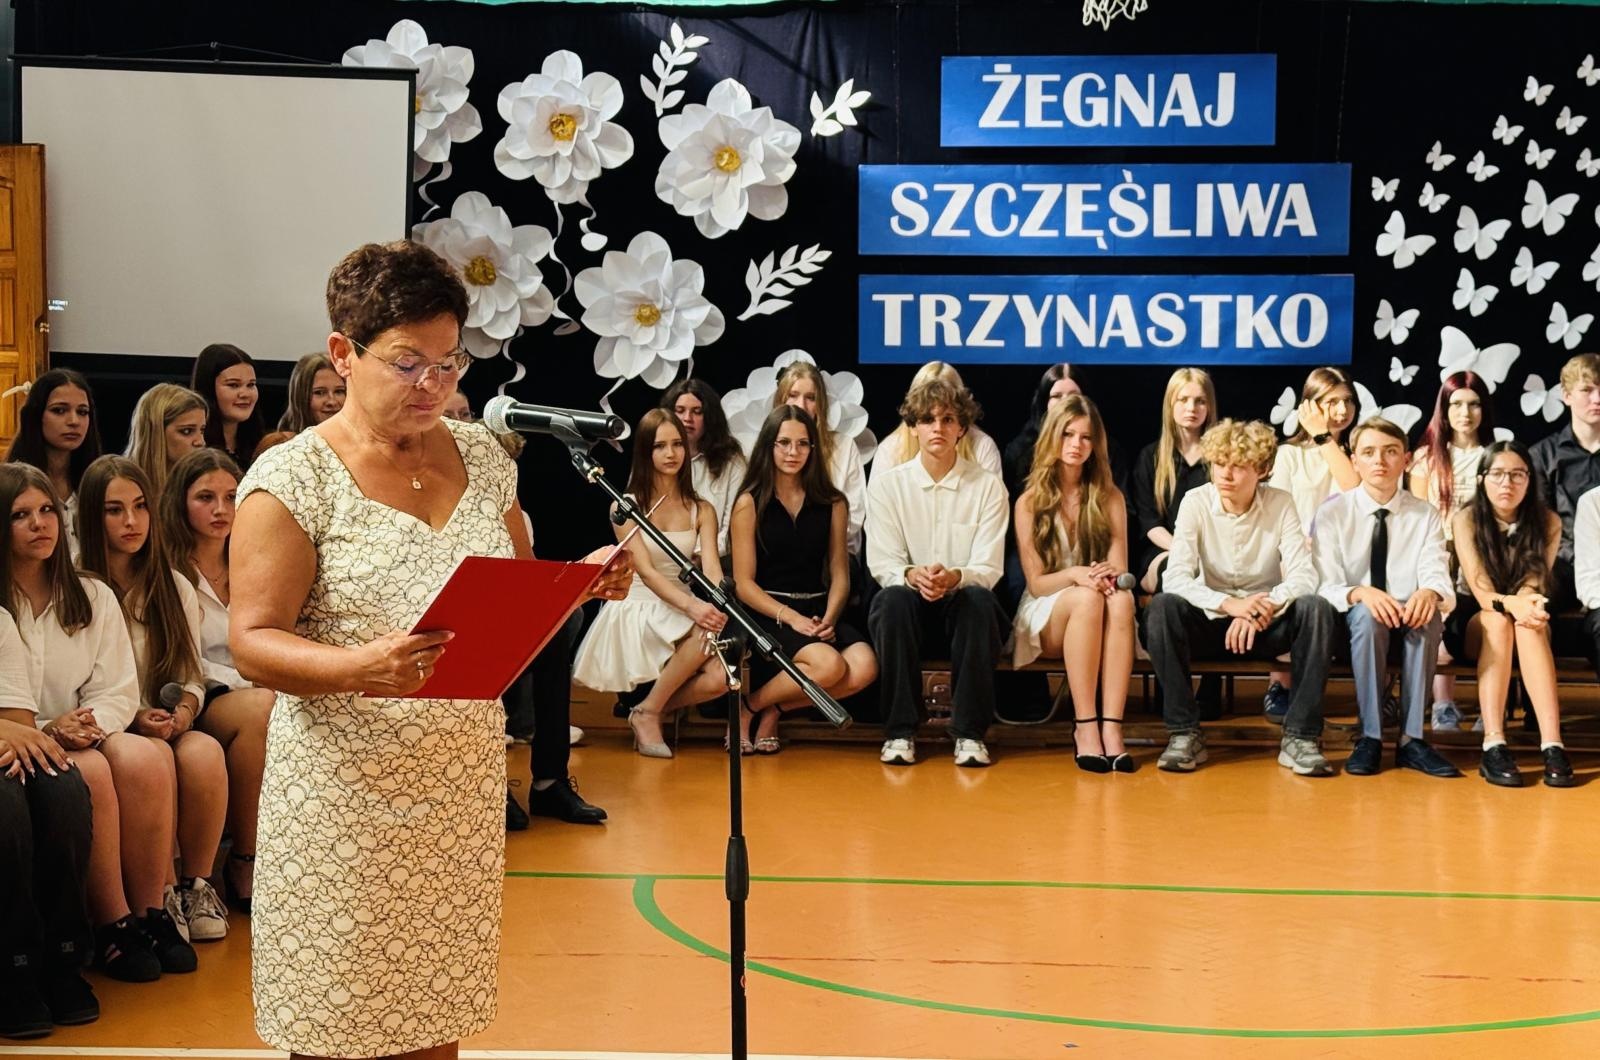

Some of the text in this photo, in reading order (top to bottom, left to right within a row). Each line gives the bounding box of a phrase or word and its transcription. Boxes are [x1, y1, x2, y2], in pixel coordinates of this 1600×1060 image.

[978, 63, 1236, 129] ŻEGNAJ
[890, 169, 1318, 250] SZCZĘŚLIWA
[871, 292, 1330, 349] TRZYNASTKO
